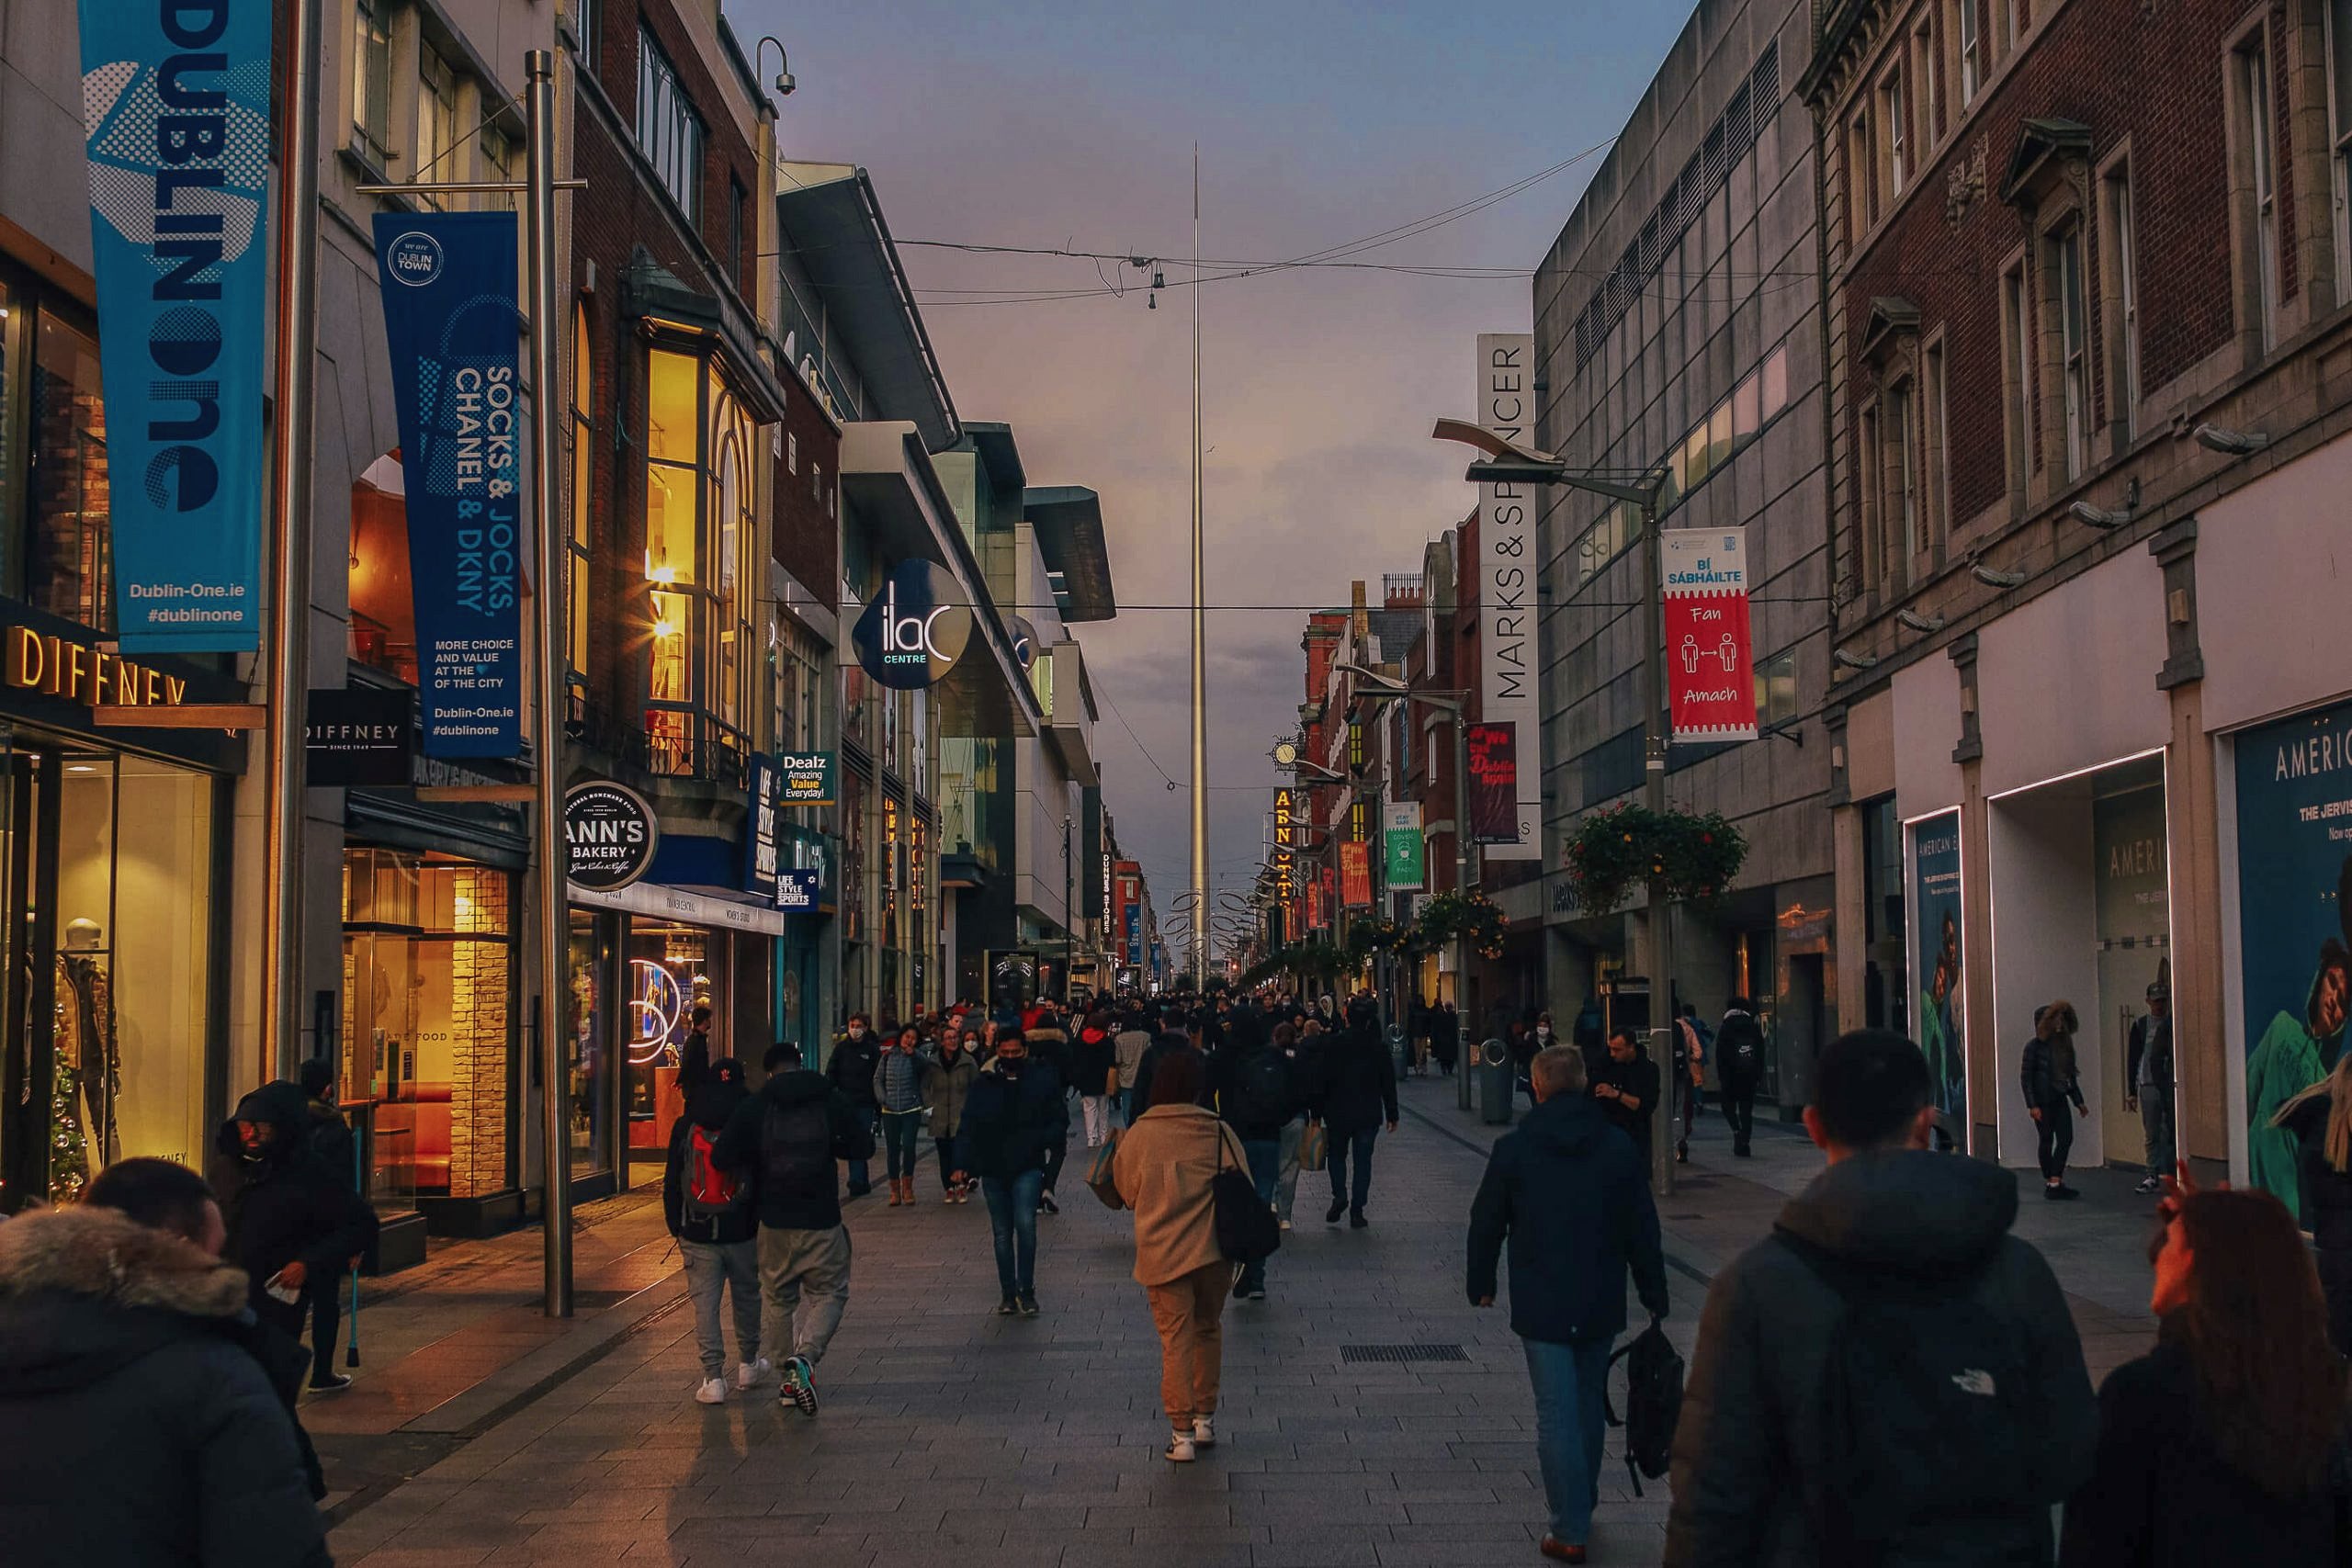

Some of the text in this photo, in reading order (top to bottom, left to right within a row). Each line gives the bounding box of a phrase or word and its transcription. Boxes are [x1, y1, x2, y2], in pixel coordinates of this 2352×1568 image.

[398, 252, 432, 264] DUBLIN
[398, 260, 431, 272] TOWN
[455, 367, 483, 613] CHANEL & DKNY
[485, 366, 514, 618] SOCKS & JOCKS,
[1492, 345, 1526, 699] MARKS & SPNCER
[1697, 558, 1711, 571] BÍ
[1677, 570, 1742, 584] SÁBHÁILTE
[130, 583, 245, 599] Dublin-One.ie
[147, 608, 244, 623] #dublinone
[1690, 607, 1722, 623] Fan
[435, 639, 514, 650] MORE CHOICE
[435, 653, 499, 663] AND VALUE
[884, 655, 927, 664] CENTRE
[435, 666, 474, 676] AT THE
[435, 678, 503, 689] OF THE CITY
[1682, 688, 1737, 705] Amach
[435, 707, 514, 718] Dublin-One.ie
[433, 725, 500, 736] #dublinone
[784, 756, 826, 769] Dealz
[787, 771, 823, 781] Amazing
[791, 780, 820, 788] Value
[786, 789, 824, 798] Everyday!
[2300, 807, 2319, 822] THE
[572, 847, 627, 858] BAKERY
[778, 875, 794, 885] LIFE
[778, 885, 802, 894] STYLE
[777, 895, 808, 905] SPORTS
